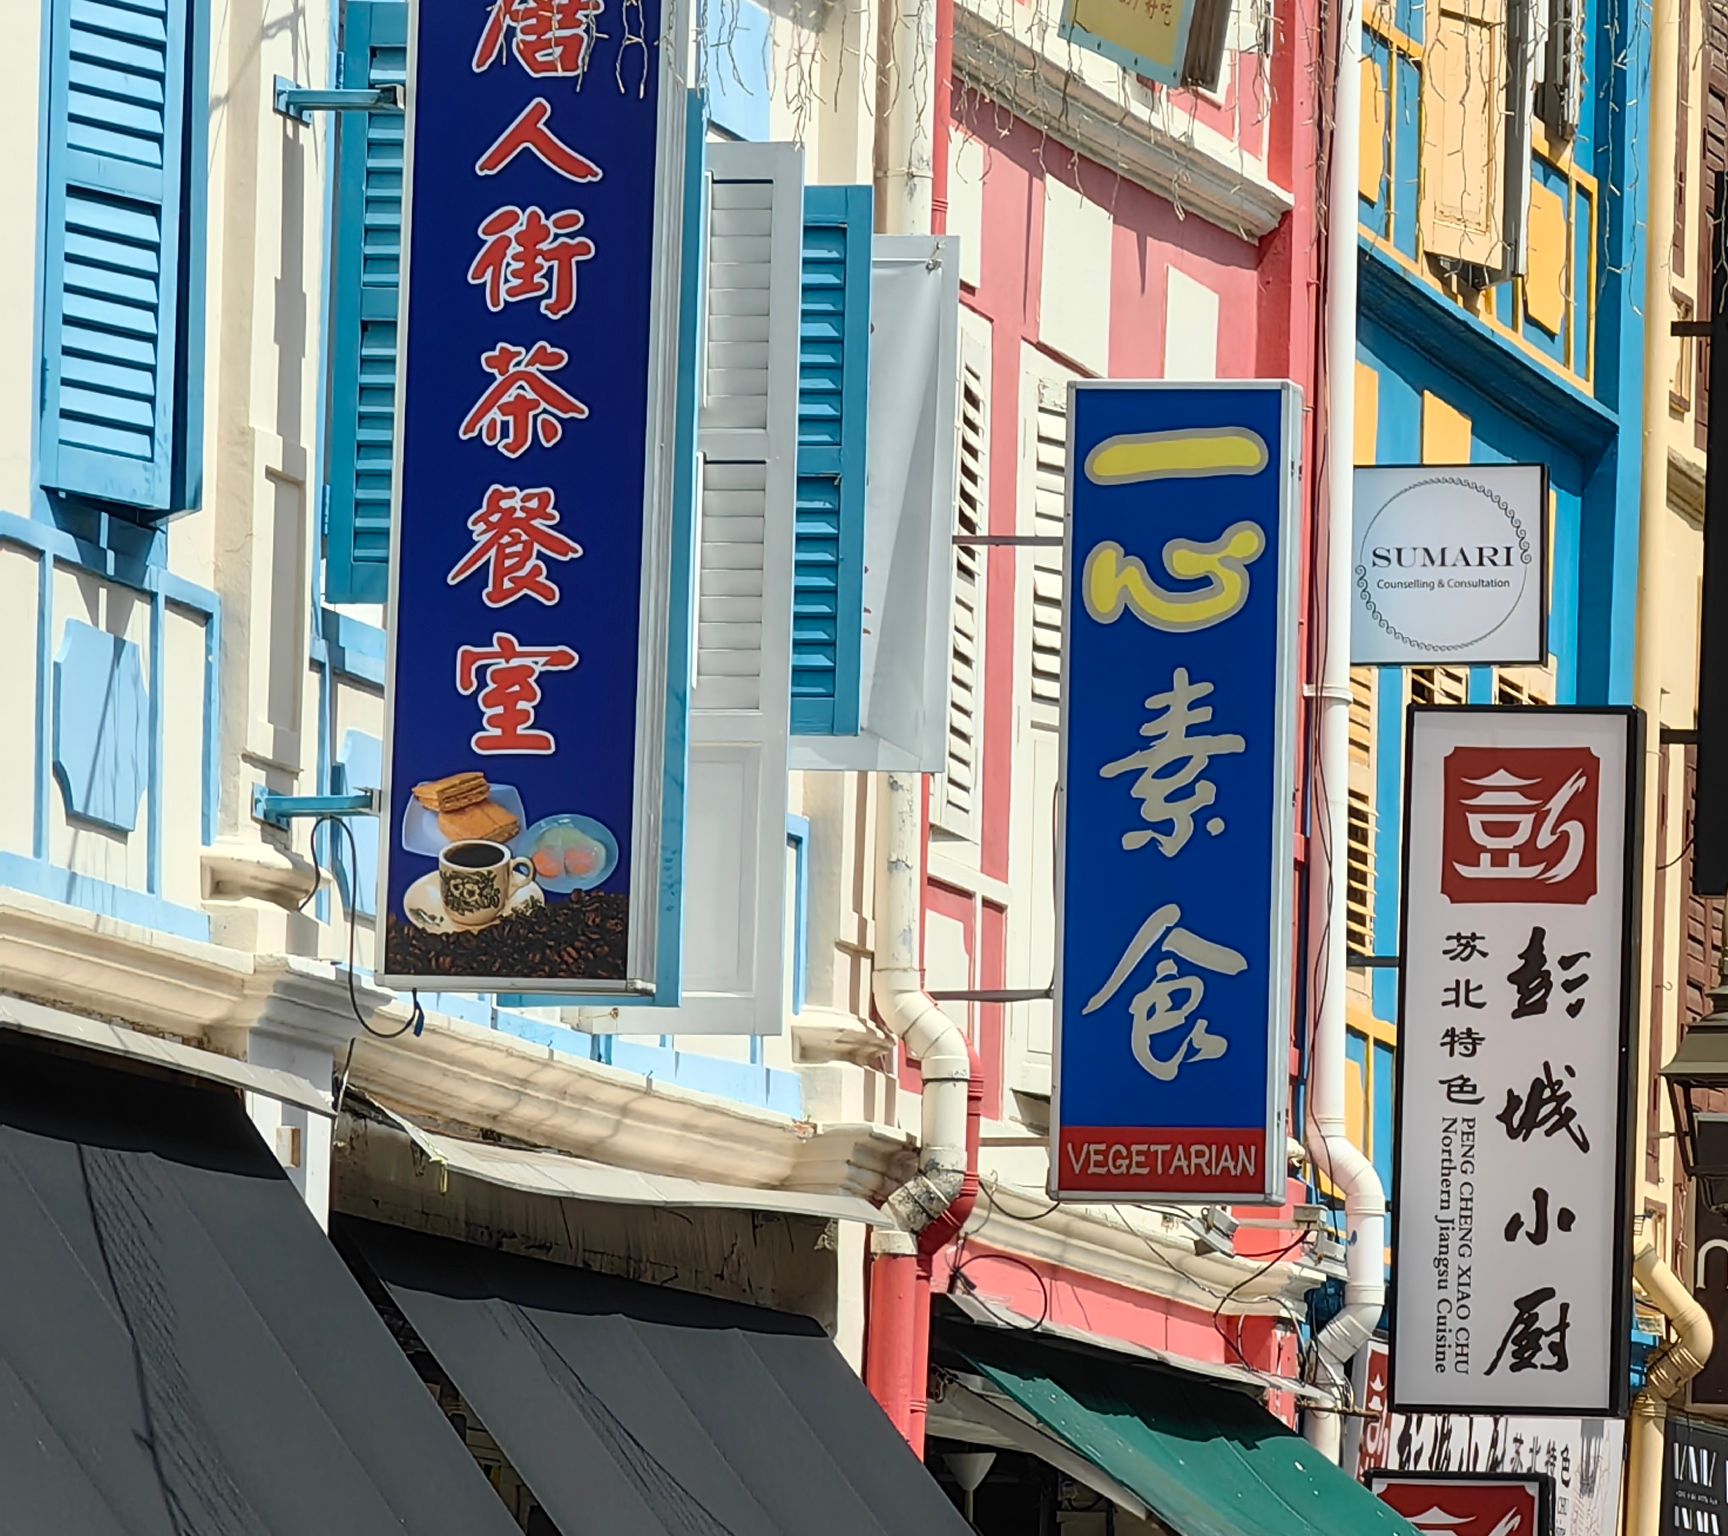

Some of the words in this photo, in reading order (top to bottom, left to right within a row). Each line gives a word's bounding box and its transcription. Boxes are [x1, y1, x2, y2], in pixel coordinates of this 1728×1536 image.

[1372, 547, 1514, 567] SUMARI
[1377, 579, 1434, 590] Counselling
[1437, 579, 1444, 588] &
[1447, 578, 1510, 588] Consultation
[1439, 932, 1488, 1104] 苏北特色
[1067, 1143, 1256, 1178] VEGETARIAN
[1440, 1117, 1457, 1211] Northern
[1460, 1117, 1476, 1172] PENG
[1484, 926, 1592, 1377] 彭城小厨
[1459, 1177, 1475, 1259] CHENG
[1434, 1215, 1454, 1290] Jiangsu
[1457, 1265, 1473, 1322] XIAO
[1433, 1297, 1449, 1375] Cuisine
[1455, 1330, 1470, 1375] CHU
